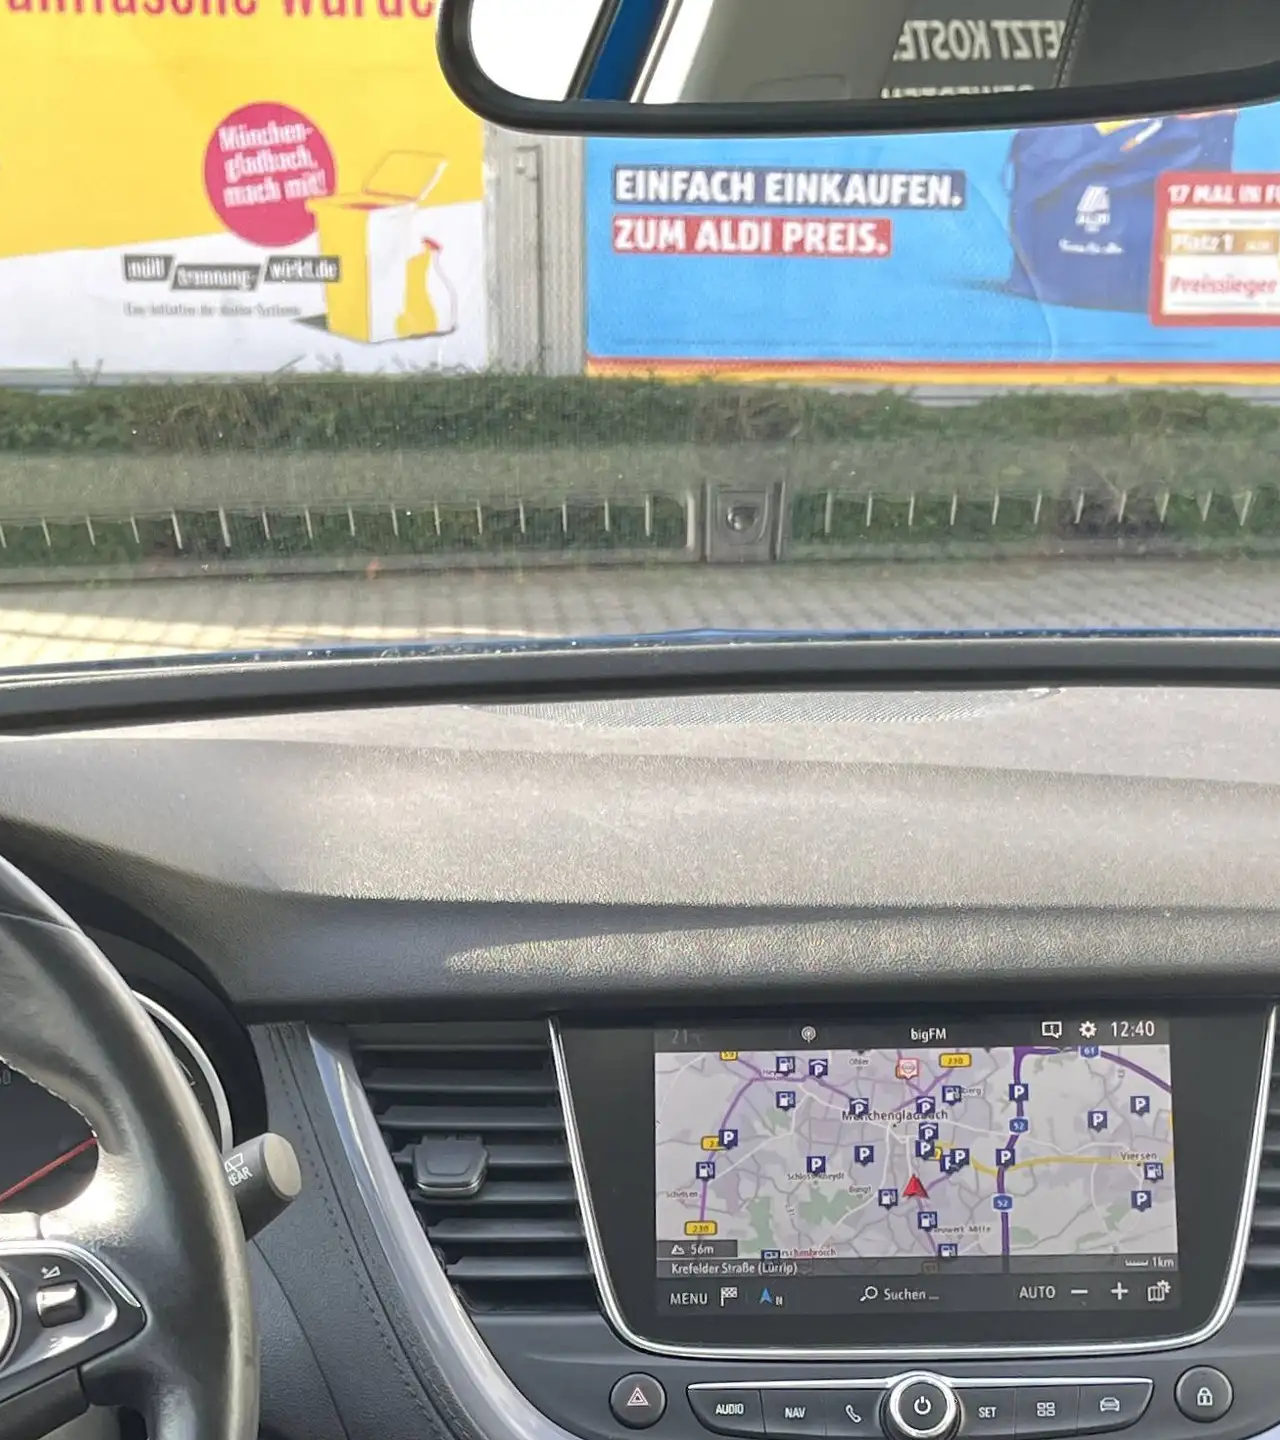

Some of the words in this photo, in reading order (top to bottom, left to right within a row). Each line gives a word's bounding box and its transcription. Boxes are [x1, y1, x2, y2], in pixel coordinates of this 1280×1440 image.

[616, 168, 756, 202] EINFACH
[765, 171, 963, 207] EINKAUFEN.
[615, 219, 686, 251] ZUM
[694, 220, 773, 252] ALDI
[782, 221, 888, 254] PREIS.
[910, 1028, 946, 1043] bigFM
[1110, 1021, 1155, 1038] 12:40
[841, 1107, 948, 1124] Mchenglaach
[691, 1244, 714, 1255] 56m
[671, 1262, 719, 1275] Krefelder
[721, 1261, 755, 1275] Straße
[758, 1260, 797, 1276] (Lürrip)
[1152, 1256, 1174, 1268] 1km
[884, 1287, 925, 1301] Suchen
[1019, 1286, 1056, 1299] AUTO
[670, 1293, 708, 1306] MENU
[715, 1403, 745, 1415] AUDIO
[784, 1407, 806, 1418] NAV
[978, 1406, 997, 1418] SET
